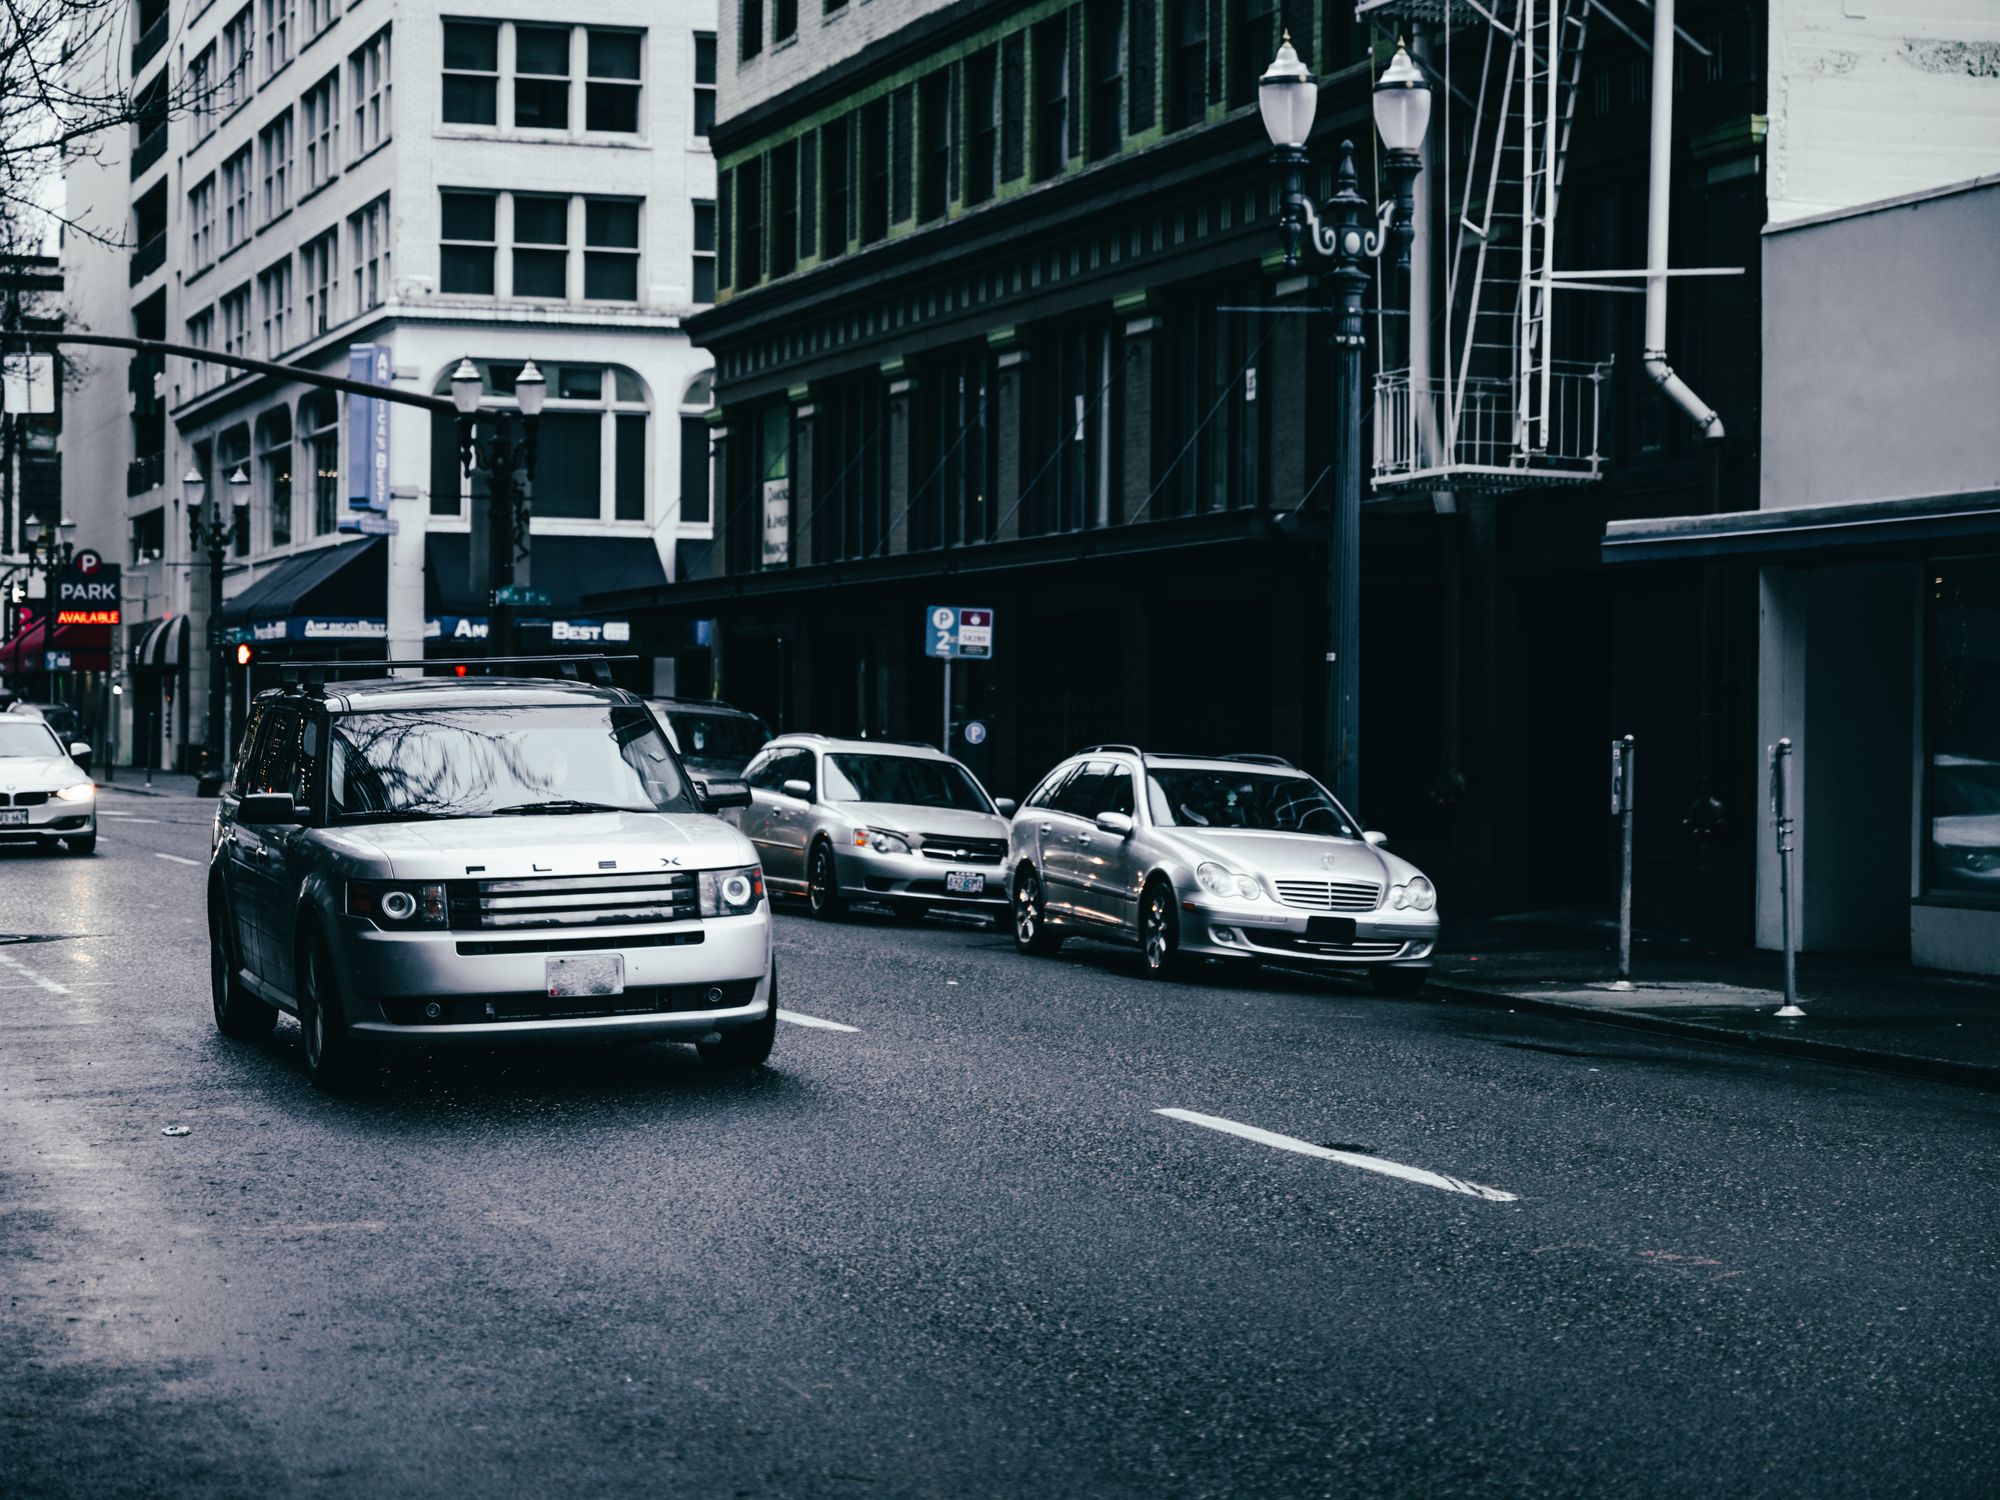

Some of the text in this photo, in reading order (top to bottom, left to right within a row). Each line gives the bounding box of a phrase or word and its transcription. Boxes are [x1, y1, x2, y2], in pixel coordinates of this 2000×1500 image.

[81, 555, 97, 572] P
[61, 583, 116, 599] PARK
[57, 610, 121, 624] AVAILABLE
[552, 621, 601, 641] BEST
[936, 630, 950, 650] 2
[465, 857, 682, 875] FLEX
